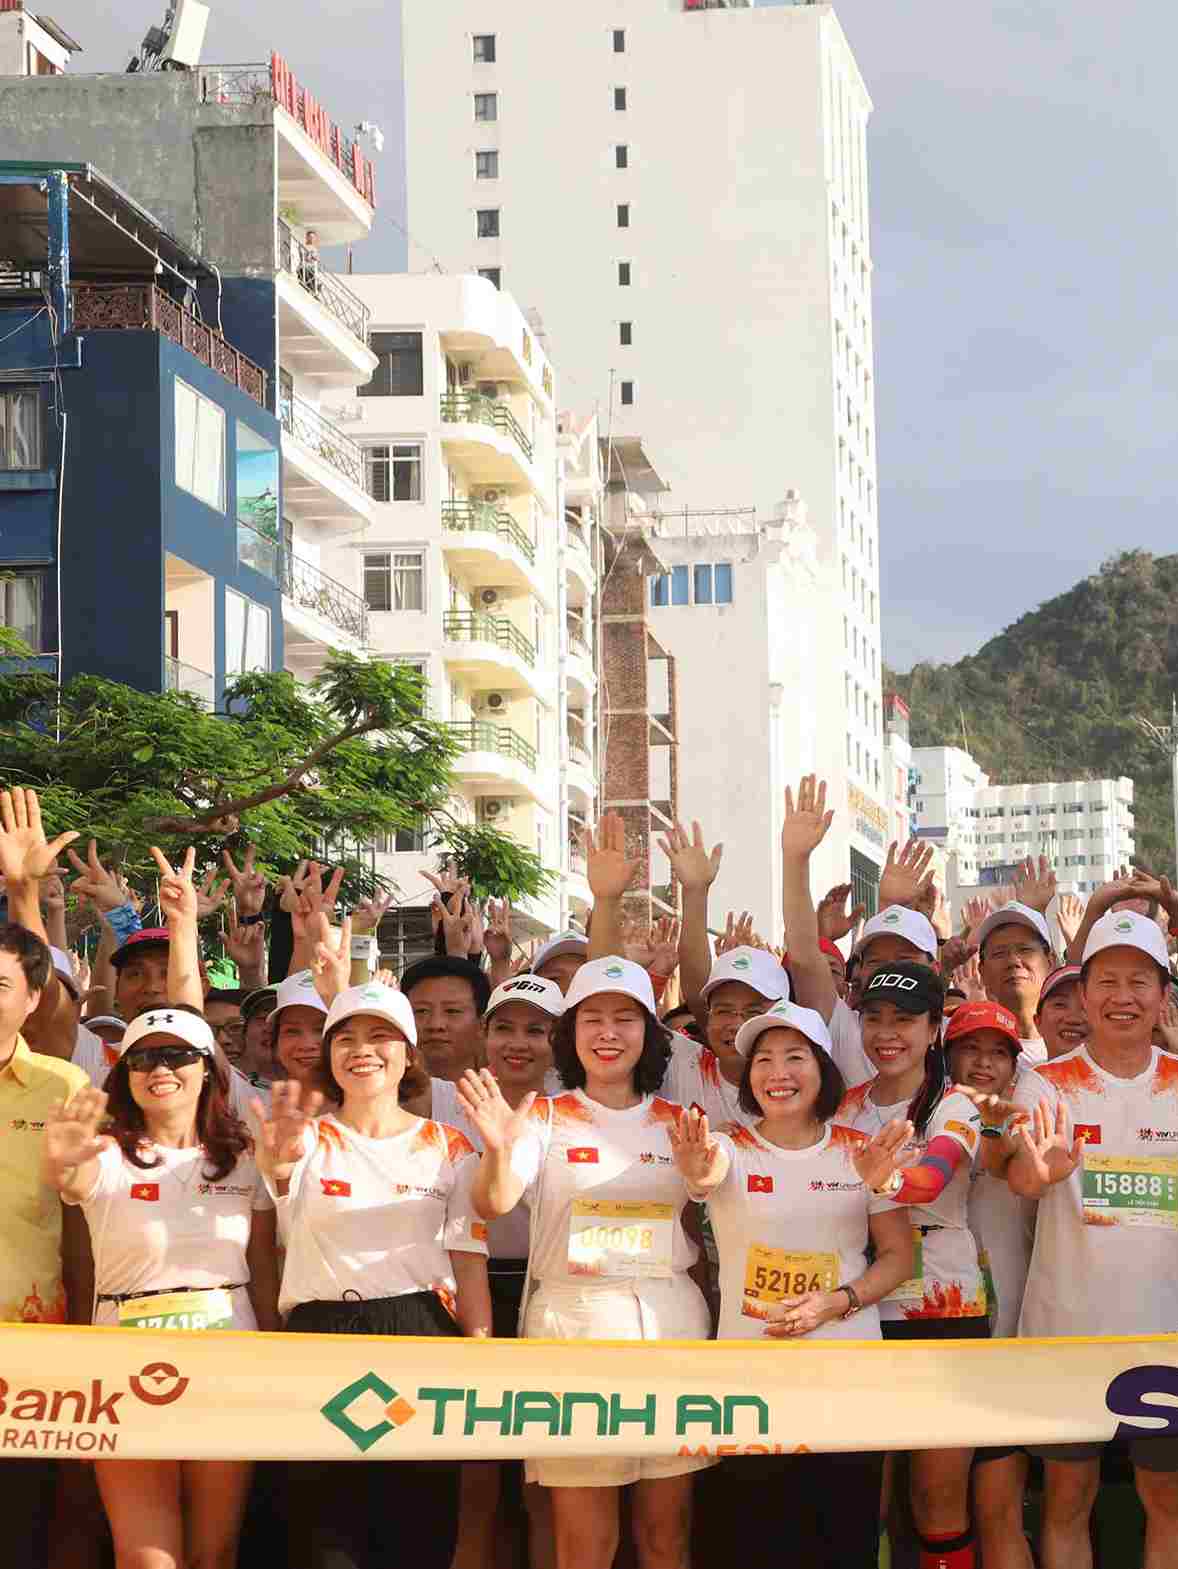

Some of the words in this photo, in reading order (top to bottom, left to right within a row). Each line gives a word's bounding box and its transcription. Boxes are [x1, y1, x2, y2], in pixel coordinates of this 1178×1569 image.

[1095, 1173, 1162, 1196] 15888
[755, 1266, 820, 1296] 52186
[418, 1387, 656, 1437] THANH
[675, 1394, 769, 1436] AN
